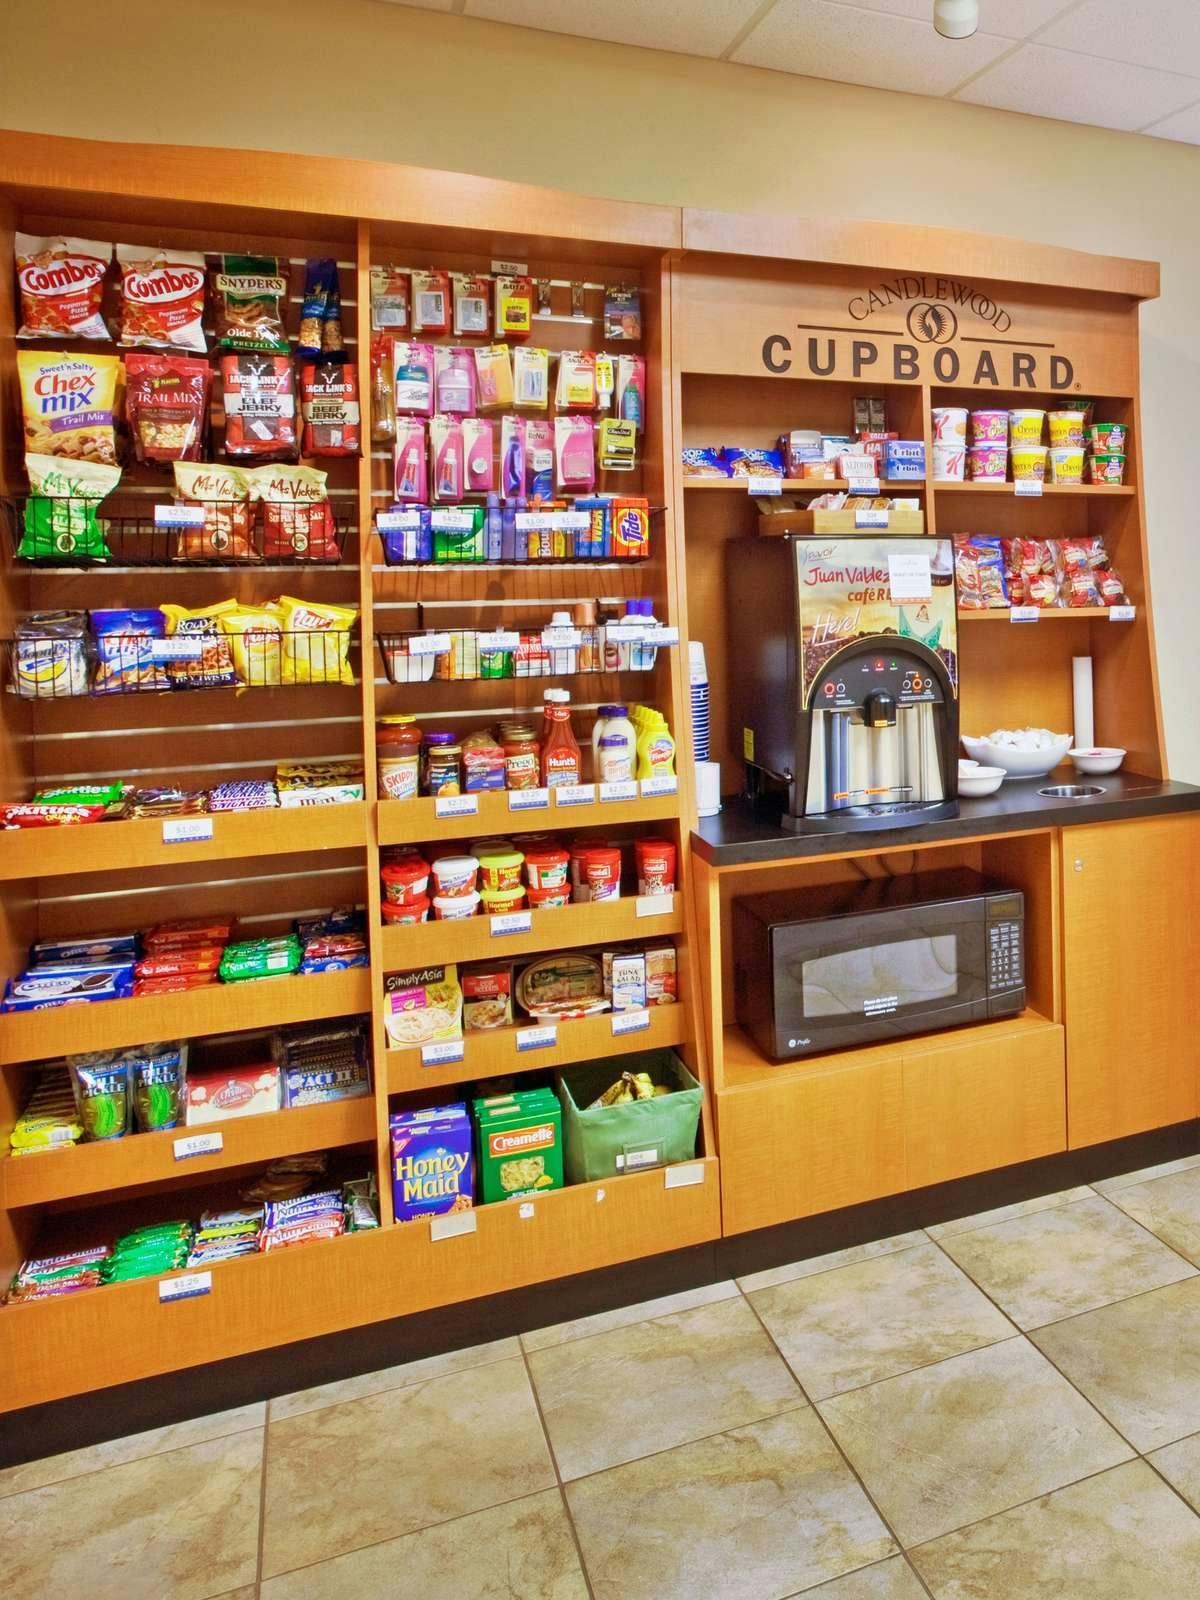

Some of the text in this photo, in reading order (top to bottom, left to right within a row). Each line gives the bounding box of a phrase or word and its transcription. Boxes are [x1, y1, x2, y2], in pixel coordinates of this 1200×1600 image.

[25, 260, 101, 290] Combos
[126, 270, 199, 298] Combos
[220, 276, 283, 290] SNYDER'S
[848, 276, 1011, 332] CANDLEWOOD
[227, 328, 252, 337] Olde
[762, 334, 1074, 390] CUPBOARD
[34, 372, 97, 396] Chex
[326, 384, 353, 393] LINK'S
[42, 388, 94, 413] mix
[136, 391, 199, 404] TRAIL MIX
[238, 404, 281, 412] JERKY
[309, 412, 347, 420] JERKY
[62, 413, 105, 426] Trail Mix
[620, 512, 644, 542] Tide
[804, 566, 844, 586] Juan
[848, 588, 875, 606] café
[811, 607, 861, 645] Here!
[548, 757, 576, 767] Hunt's
[387, 969, 443, 990] Simply Asia
[618, 968, 639, 977] TUNA
[186, 1139, 211, 1150] $1.00
[493, 1127, 553, 1152] Creamette
[396, 1152, 469, 1181] Honey
[403, 1172, 460, 1202] Maid
